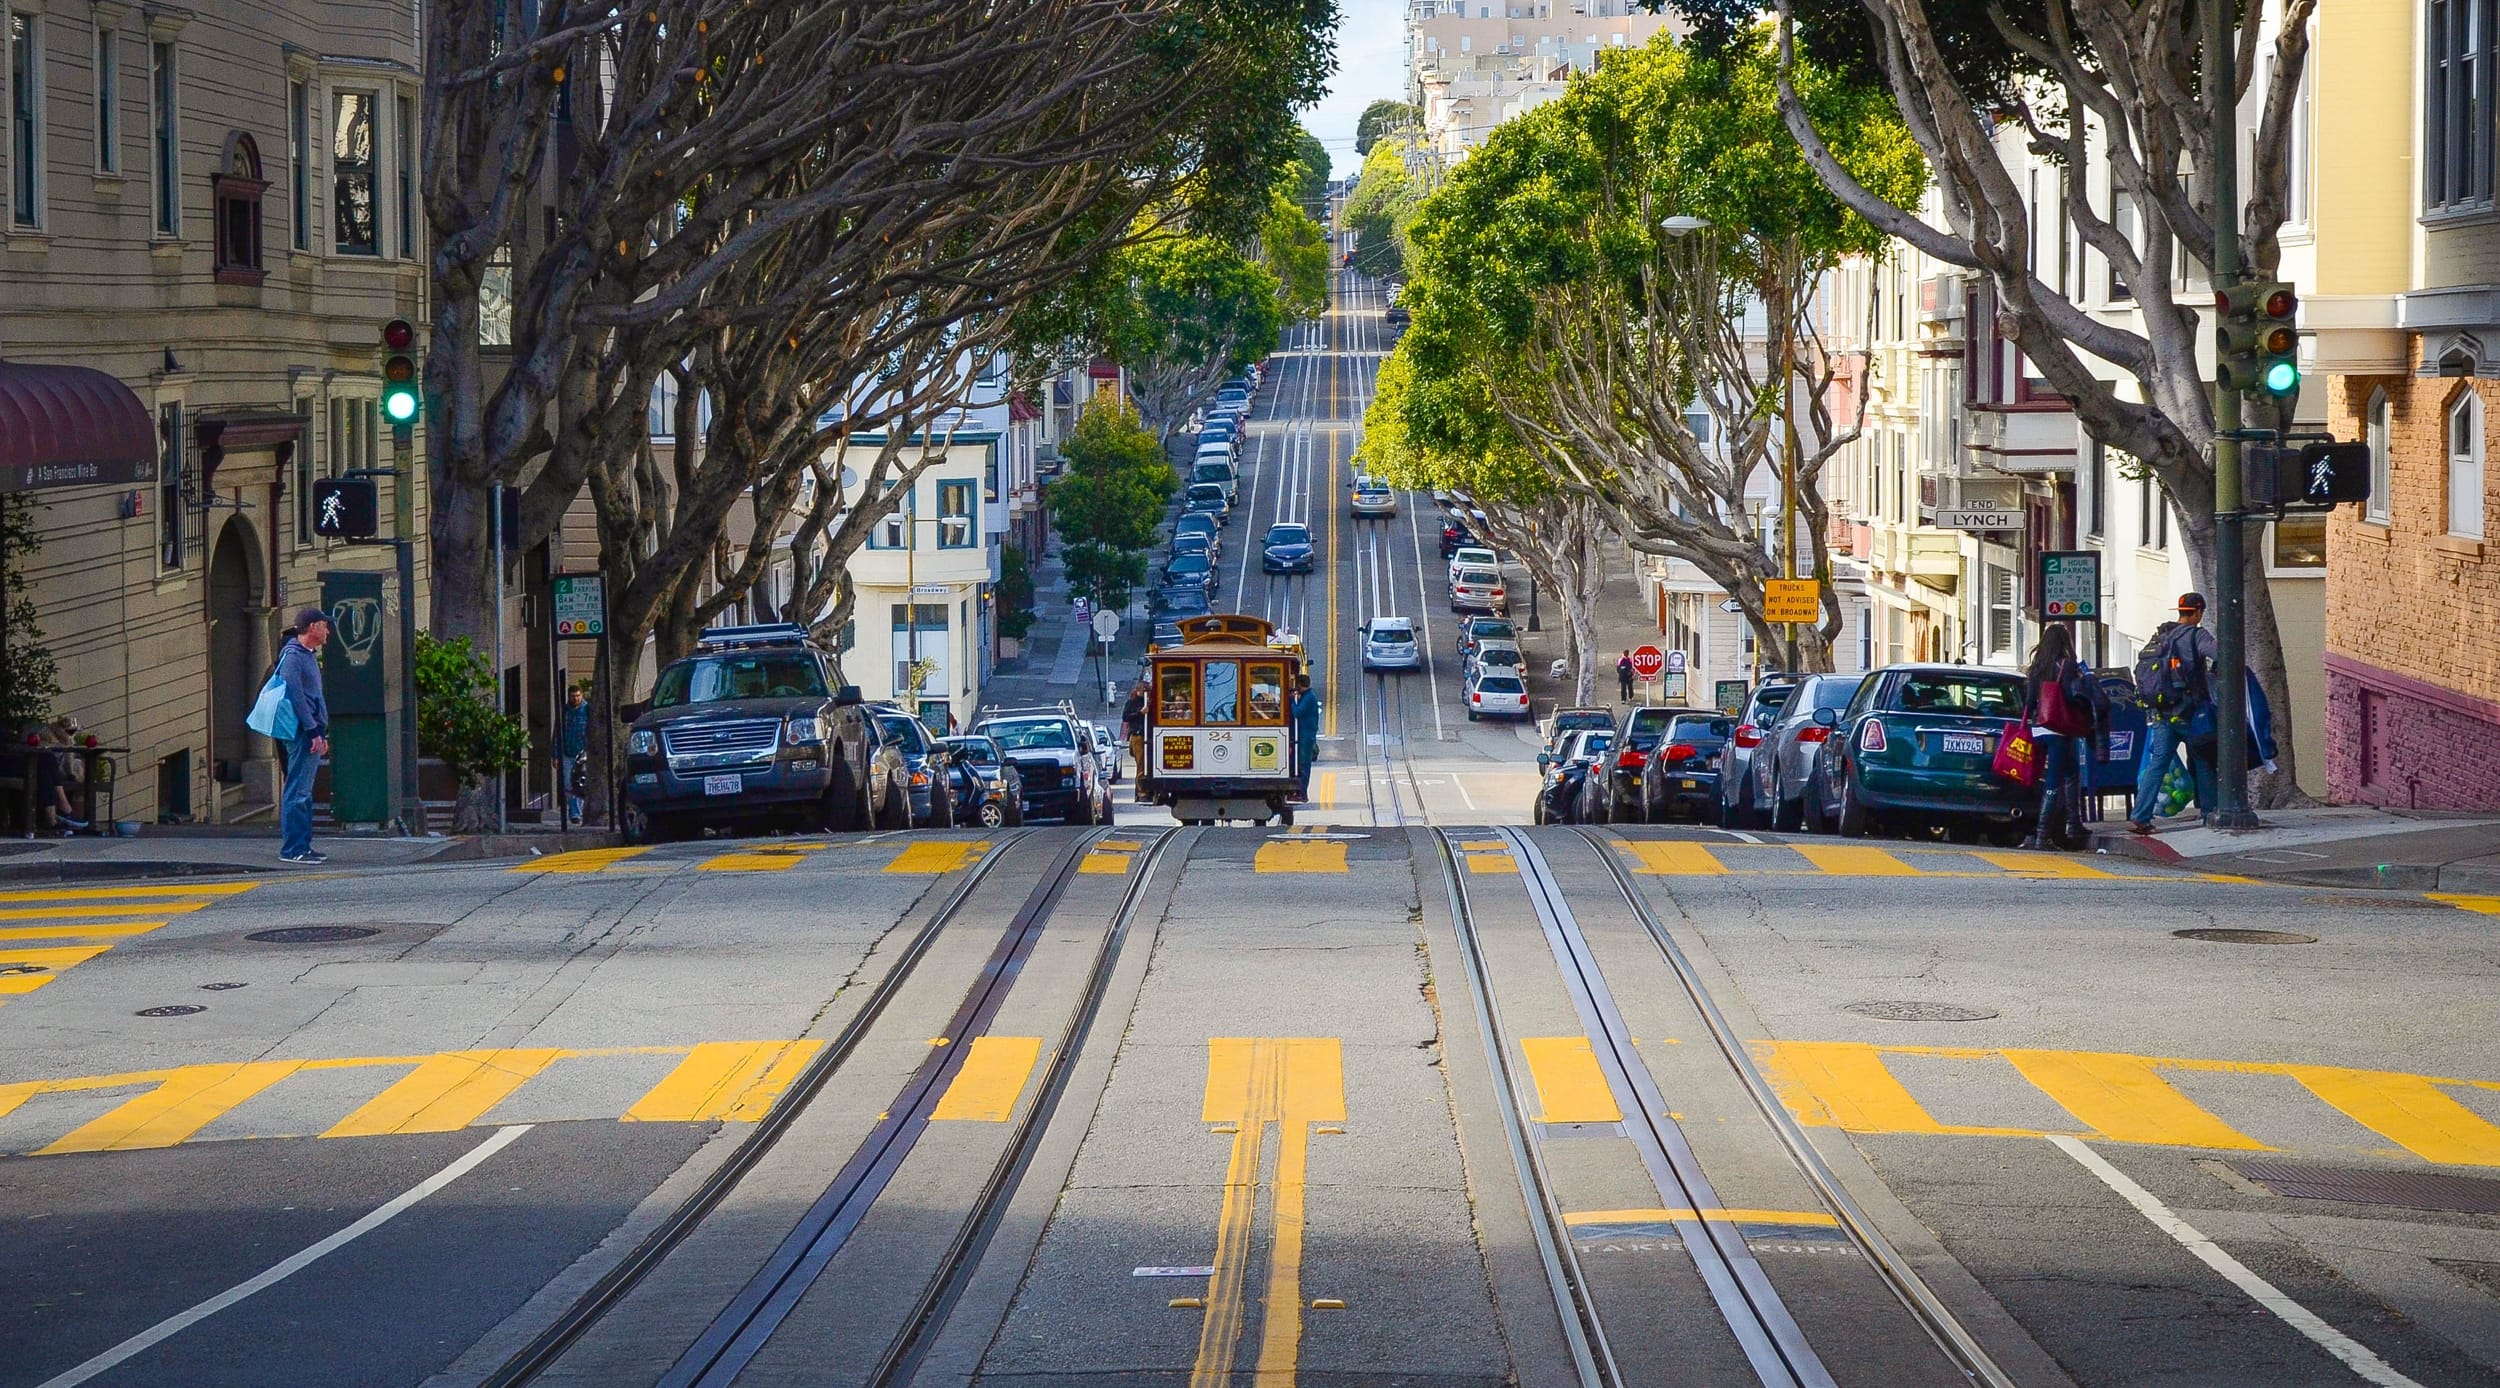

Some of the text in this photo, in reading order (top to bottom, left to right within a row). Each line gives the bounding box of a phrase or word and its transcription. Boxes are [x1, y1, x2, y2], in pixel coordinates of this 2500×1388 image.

[43, 465, 53, 480] San
[54, 464, 77, 479] Francisco
[1953, 514, 2008, 526] LYNCH
[2048, 559, 2059, 571] 2
[559, 580, 568, 593] 2
[1768, 596, 1815, 604] NOT ADVISED
[1780, 608, 1815, 616] BROADWAY
[1634, 654, 1661, 666] STOP
[1208, 731, 1233, 742] 24
